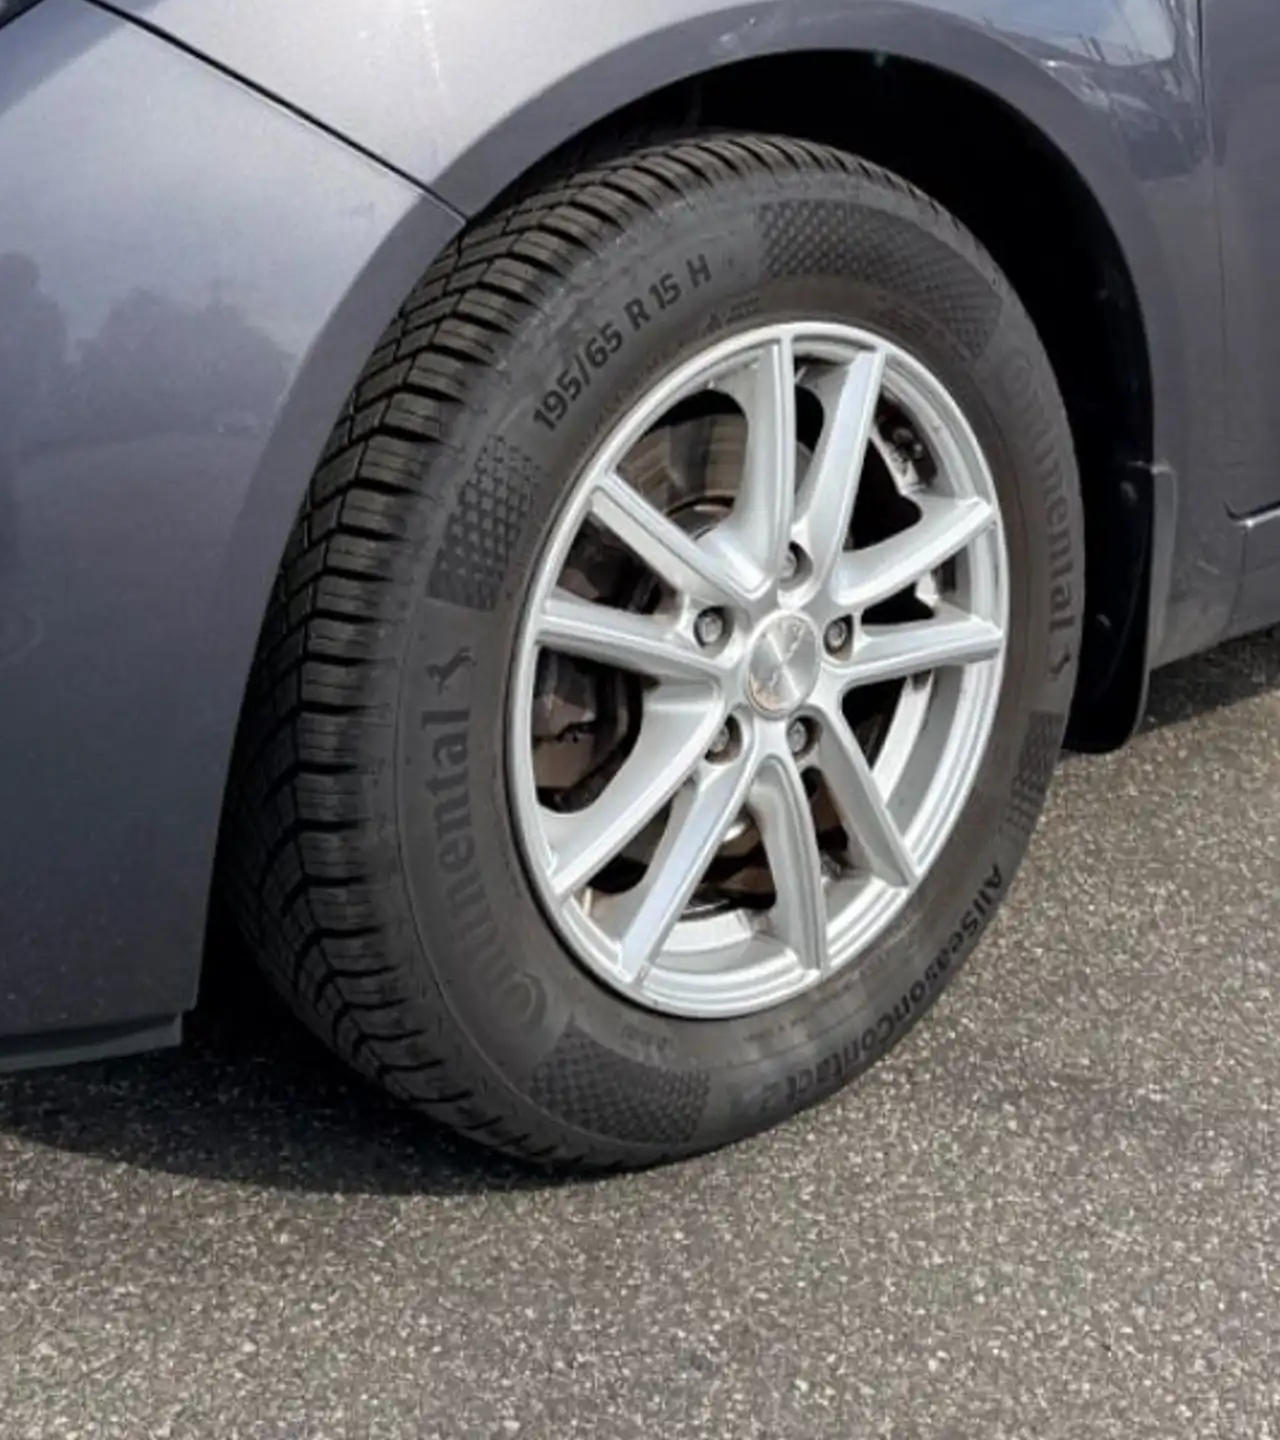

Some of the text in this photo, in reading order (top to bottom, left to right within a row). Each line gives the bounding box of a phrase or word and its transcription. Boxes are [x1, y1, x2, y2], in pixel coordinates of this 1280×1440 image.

[532, 252, 713, 432] 195/65 R 15 H
